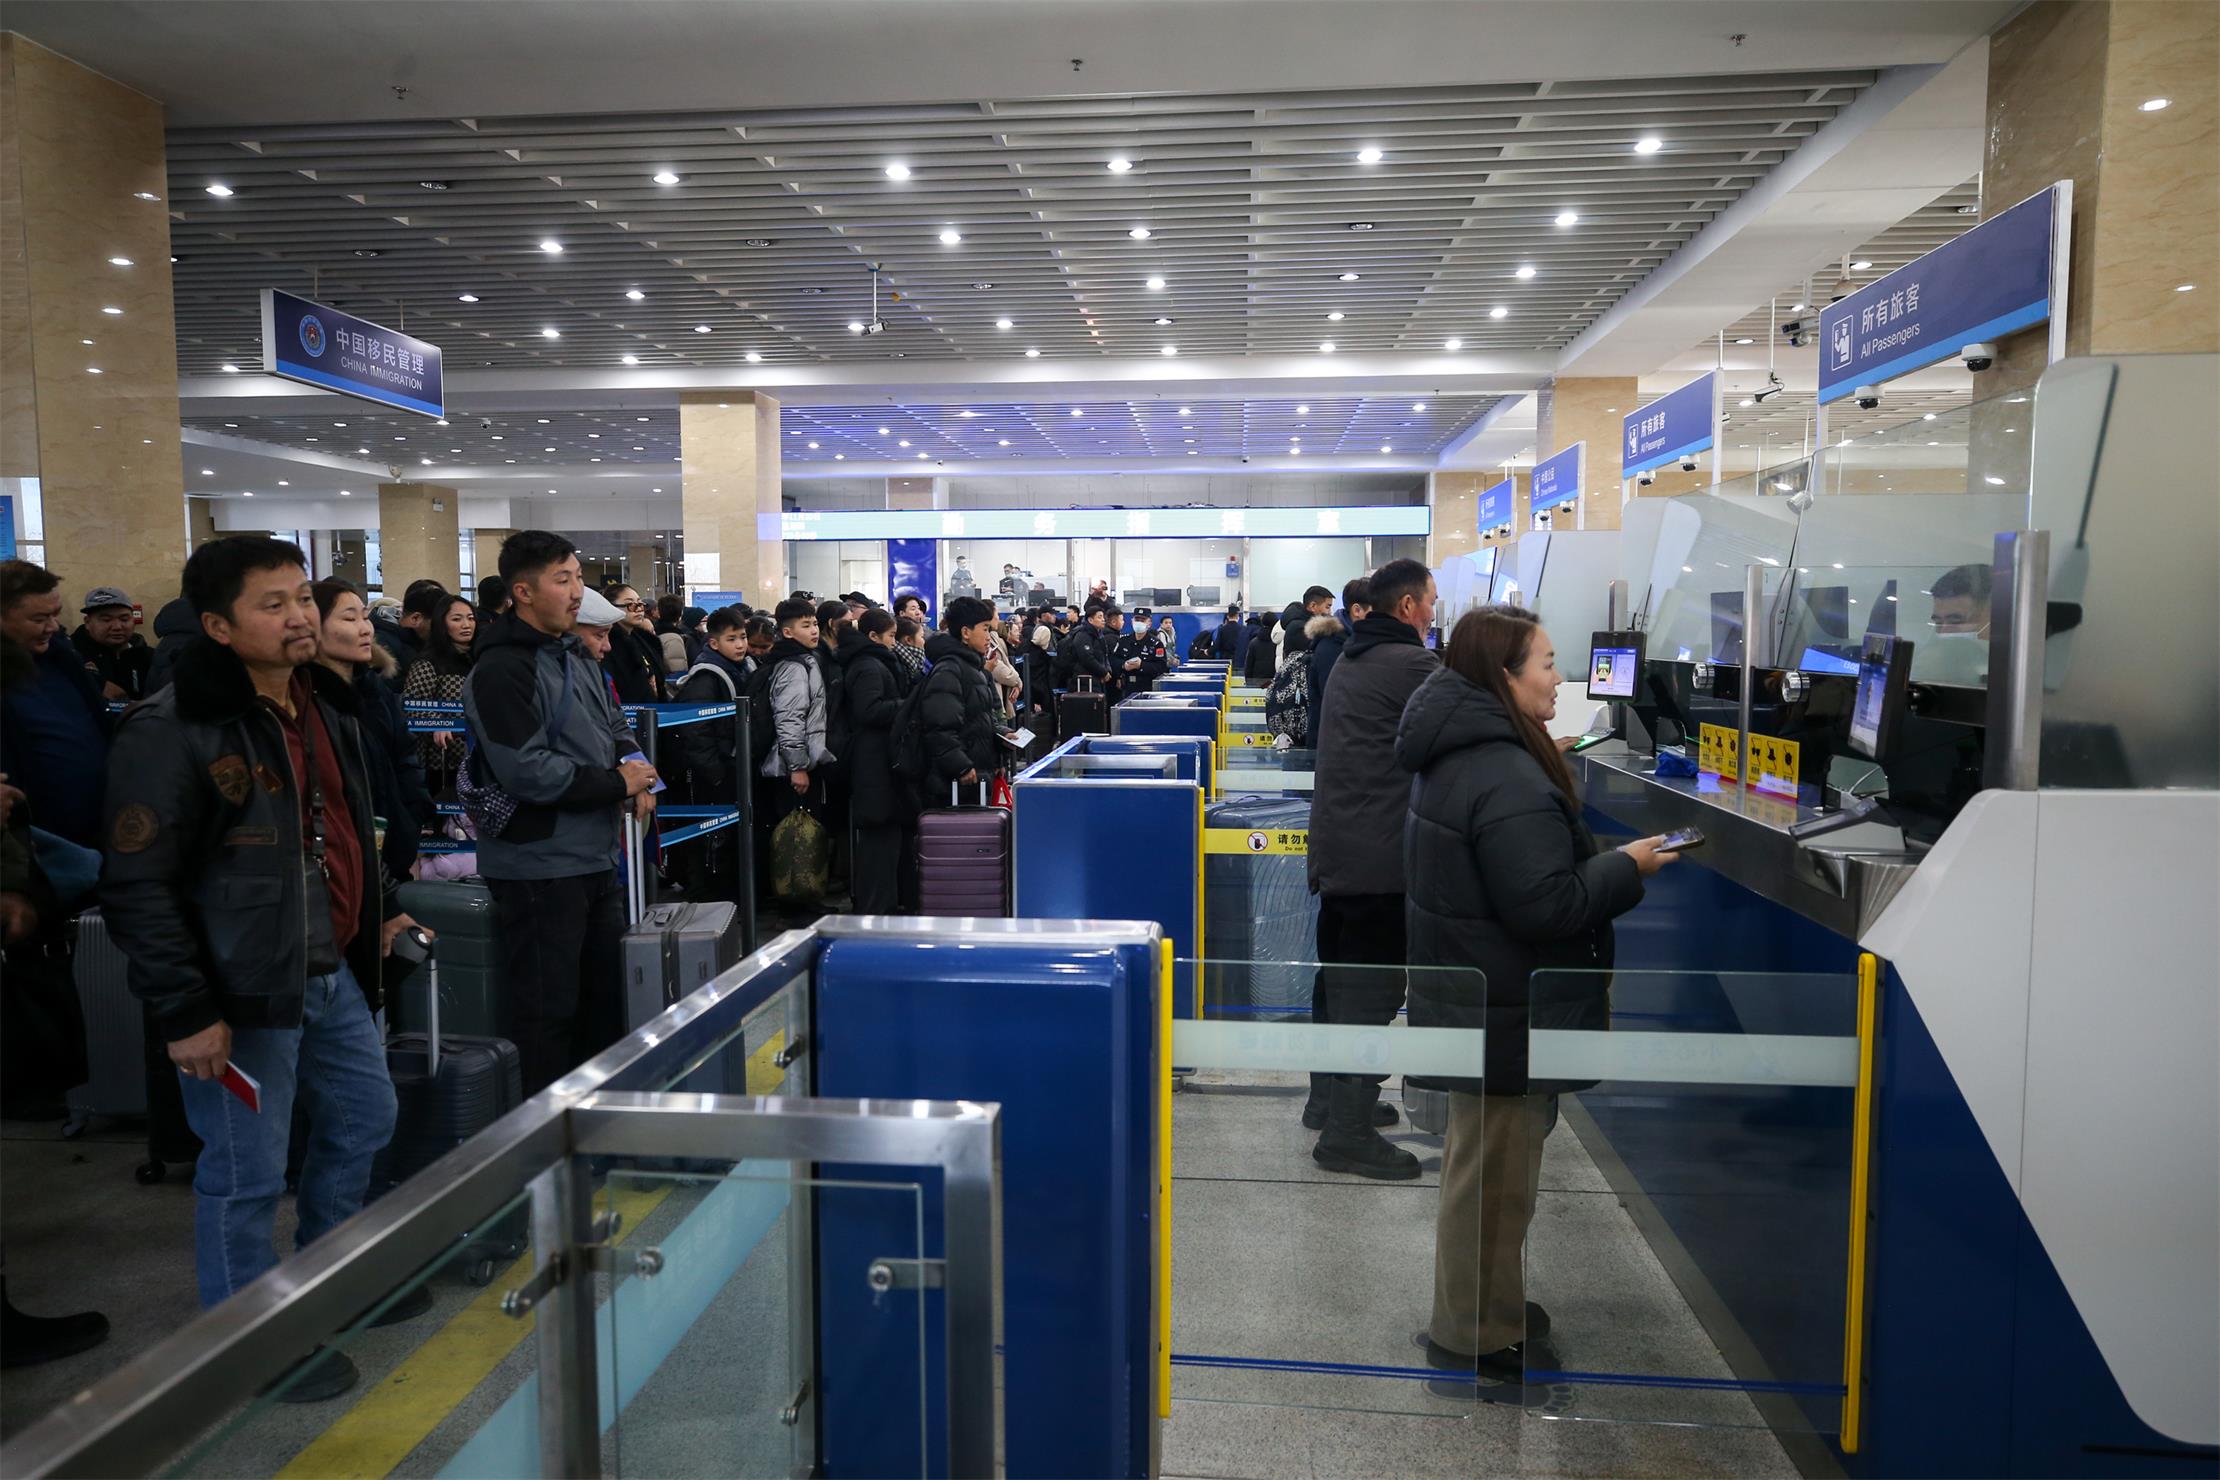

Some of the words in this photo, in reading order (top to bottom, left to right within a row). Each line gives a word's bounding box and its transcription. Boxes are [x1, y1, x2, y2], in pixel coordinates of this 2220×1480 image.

[1861, 282, 1921, 335] 所有旅客
[336, 327, 425, 376] 中国移民管理
[1860, 339, 1871, 360] All
[1872, 323, 1921, 353] Passengers
[341, 355, 368, 375] CHINA
[370, 365, 423, 391] IMMIGRATION
[1641, 411, 1666, 438] 所有旅客
